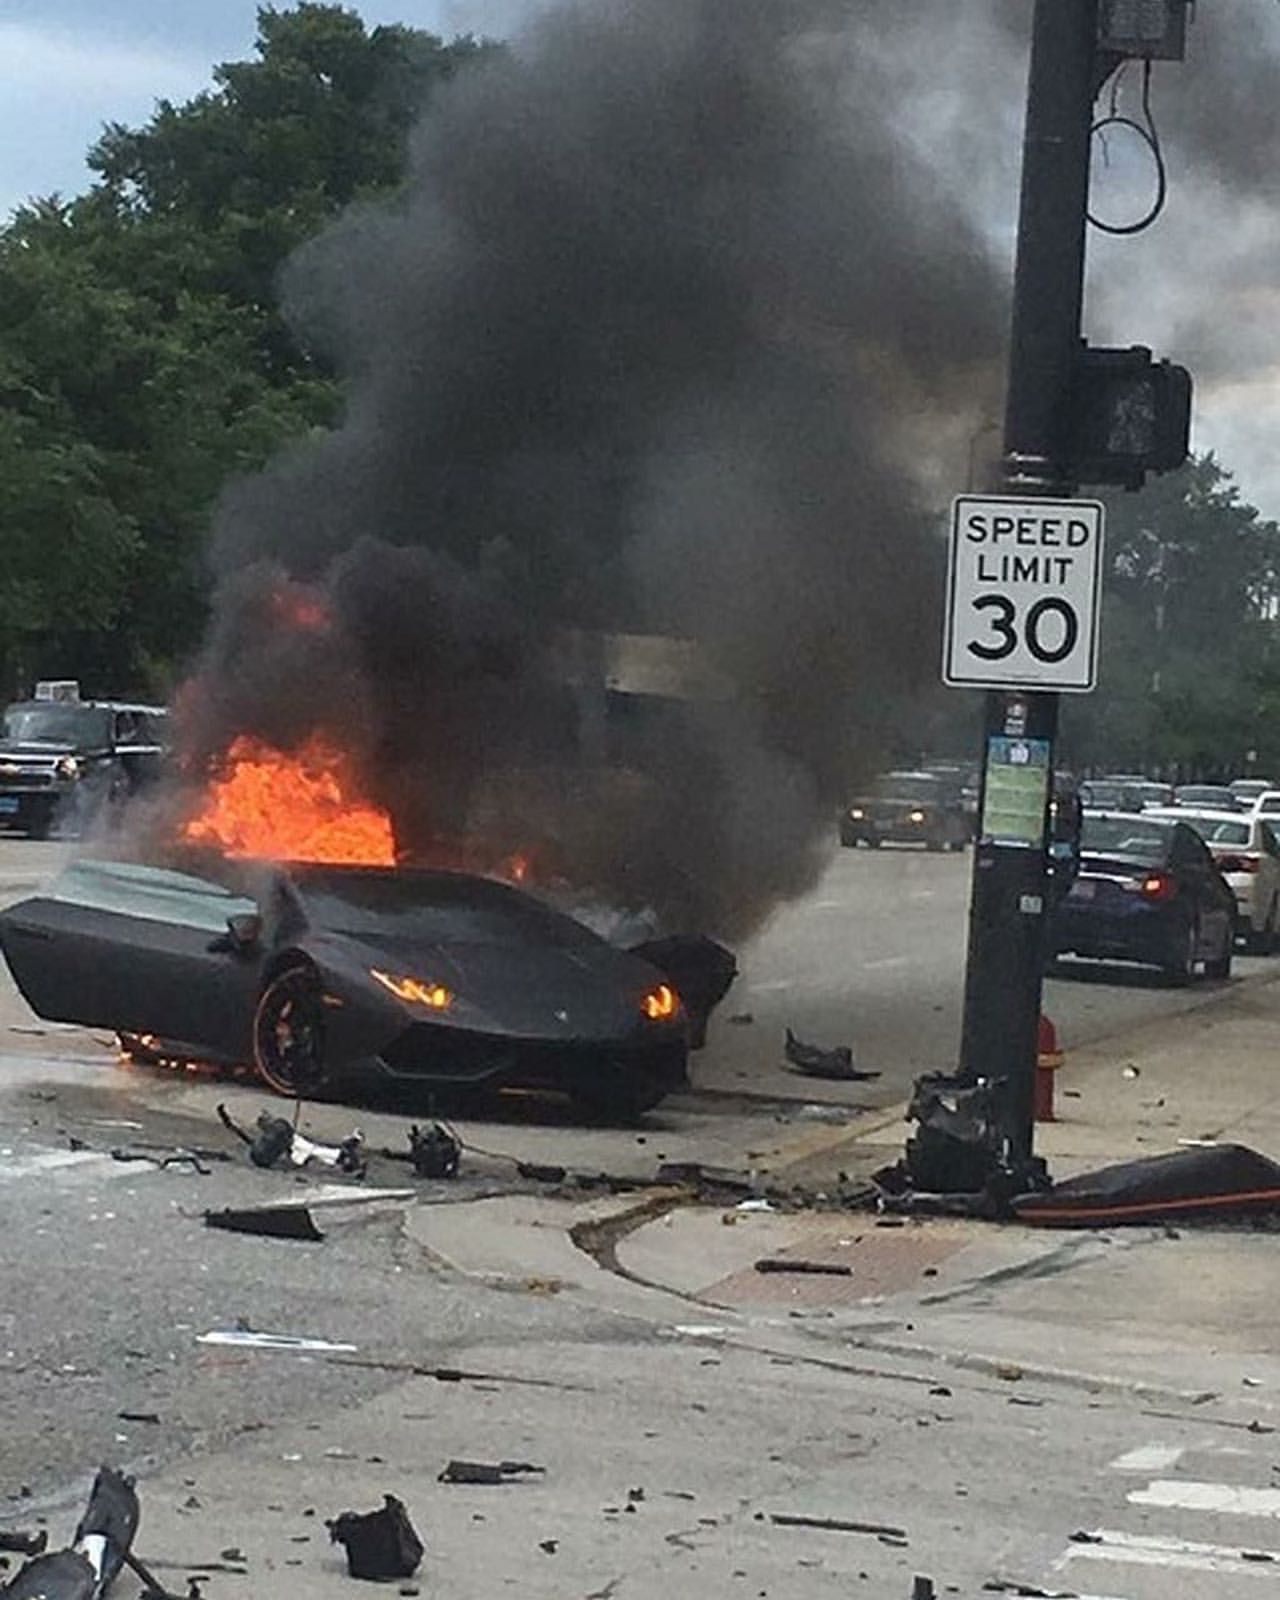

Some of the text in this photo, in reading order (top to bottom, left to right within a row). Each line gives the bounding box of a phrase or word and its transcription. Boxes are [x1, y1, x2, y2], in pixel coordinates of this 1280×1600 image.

[966, 515, 1089, 547] SPEED
[977, 553, 1073, 585] LIMIT
[966, 593, 1078, 664] 30
